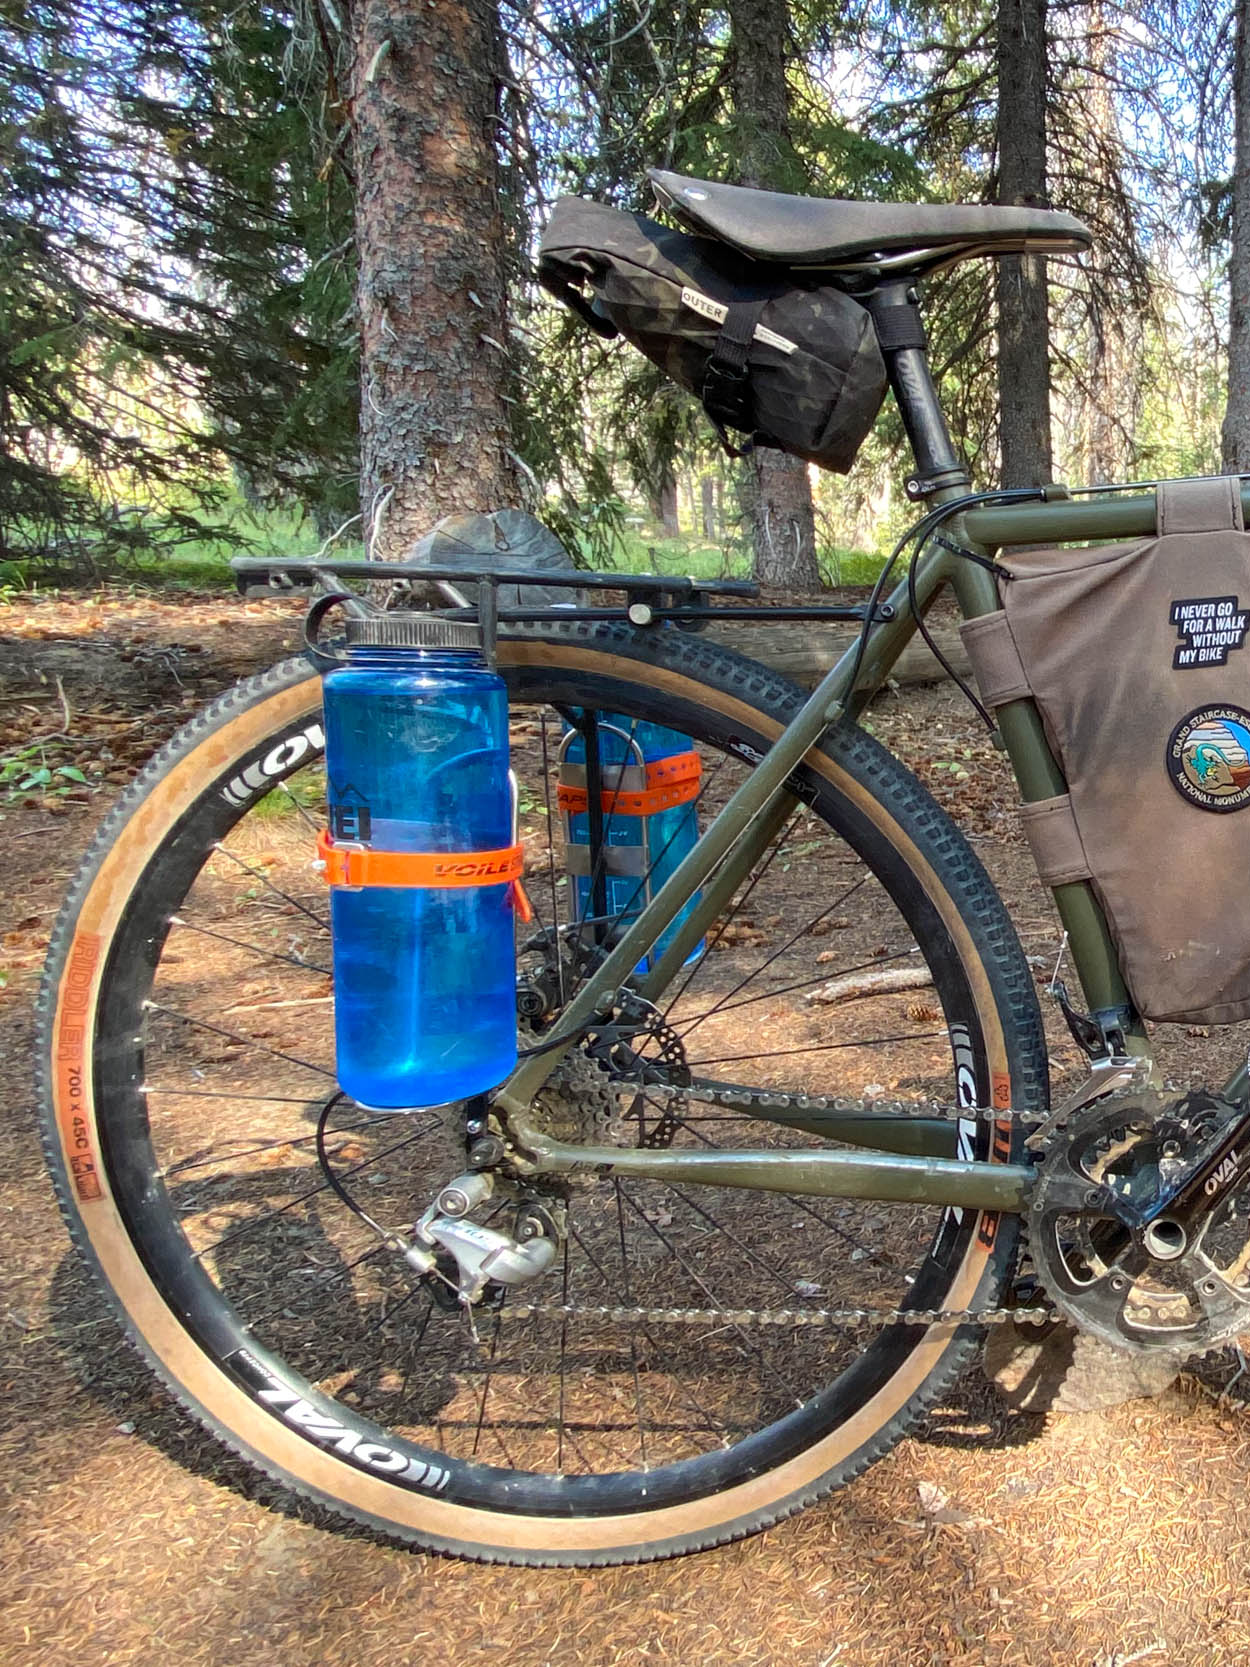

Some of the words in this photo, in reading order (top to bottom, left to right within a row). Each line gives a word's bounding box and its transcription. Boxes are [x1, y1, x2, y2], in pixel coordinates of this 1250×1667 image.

[683, 292, 722, 318] OUTER
[1174, 606, 1180, 621] I
[1180, 604, 1215, 620] NEVER
[1217, 602, 1233, 617] GO
[1183, 619, 1204, 634] FOR
[1205, 618, 1213, 632] A
[1215, 615, 1246, 631] WALK
[1179, 649, 1197, 664] MY
[1198, 646, 1224, 662] BIKE
[1192, 630, 1242, 648] WITHOUT
[1172, 726, 1191, 759] GRAND
[1176, 771, 1213, 804] NATIONAL
[330, 805, 372, 841] EI
[57, 934, 101, 1061] RIDDLER
[67, 1066, 82, 1098] 700
[70, 1103, 80, 1112] x
[72, 1116, 89, 1149] 45C
[1204, 1149, 1241, 1196] OVAL
[257, 1377, 409, 1473] OVAL
